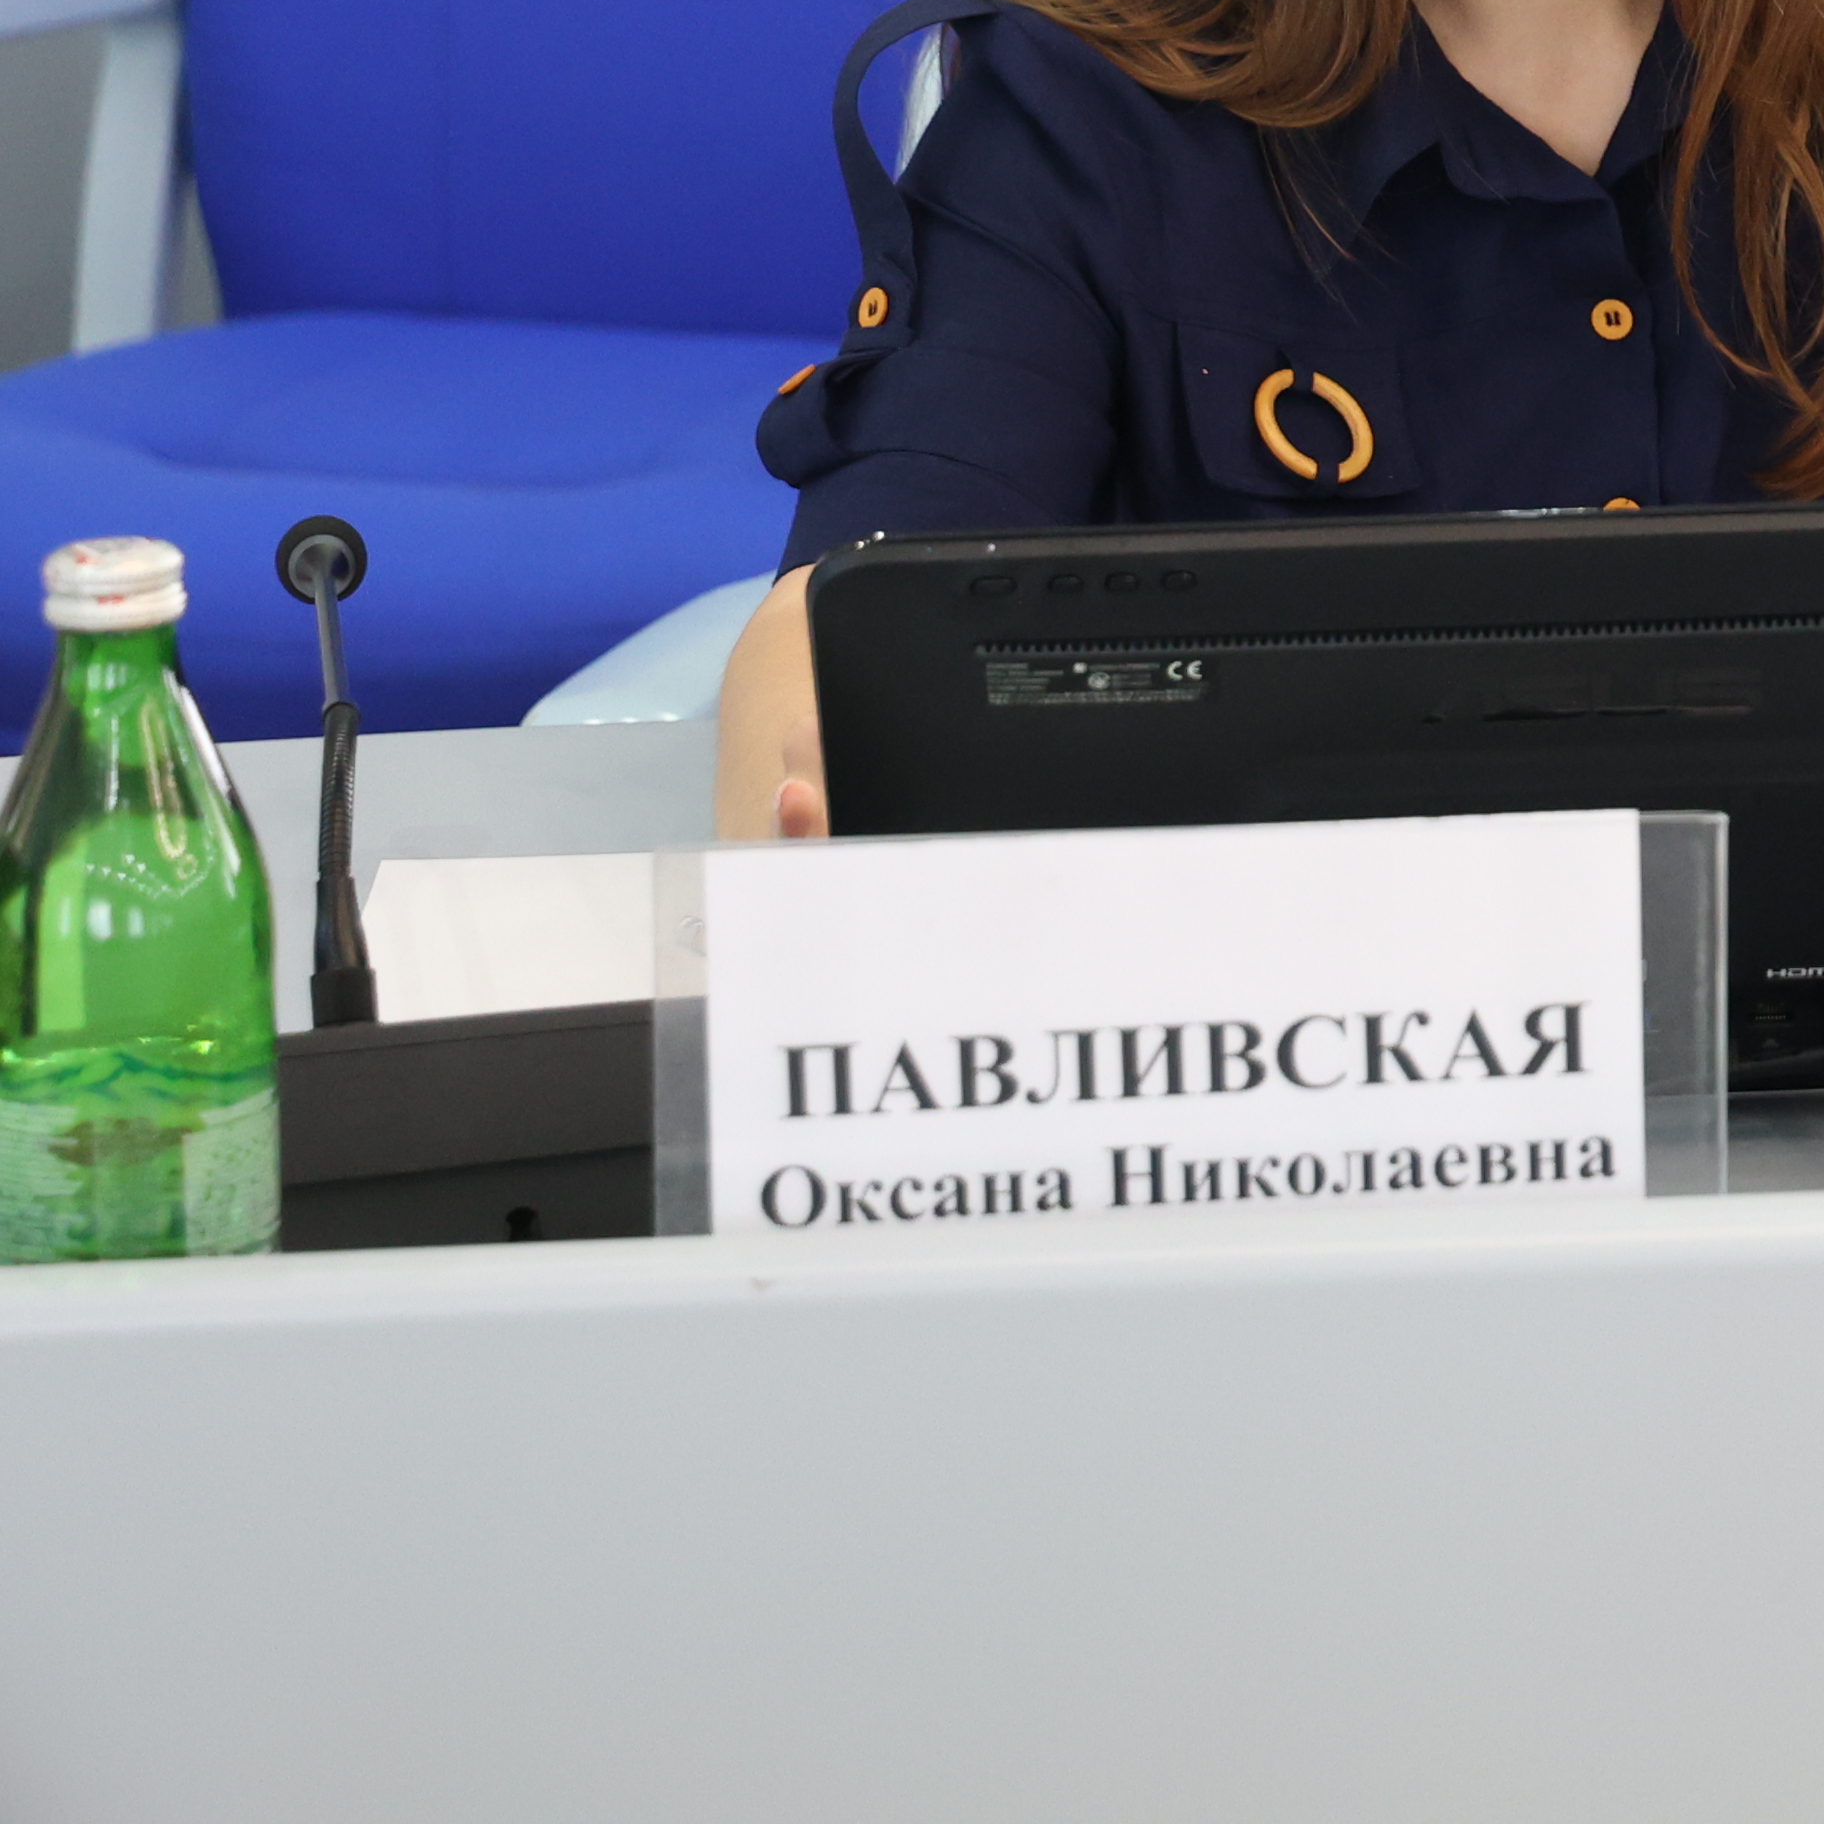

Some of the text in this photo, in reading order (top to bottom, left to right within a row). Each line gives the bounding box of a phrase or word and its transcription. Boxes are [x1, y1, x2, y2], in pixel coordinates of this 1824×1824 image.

[1165, 659, 1204, 682] CE
[780, 1000, 1592, 1120] ПАВЛИВСКАЯ
[759, 1135, 1619, 1230] Оксана Николаевна
